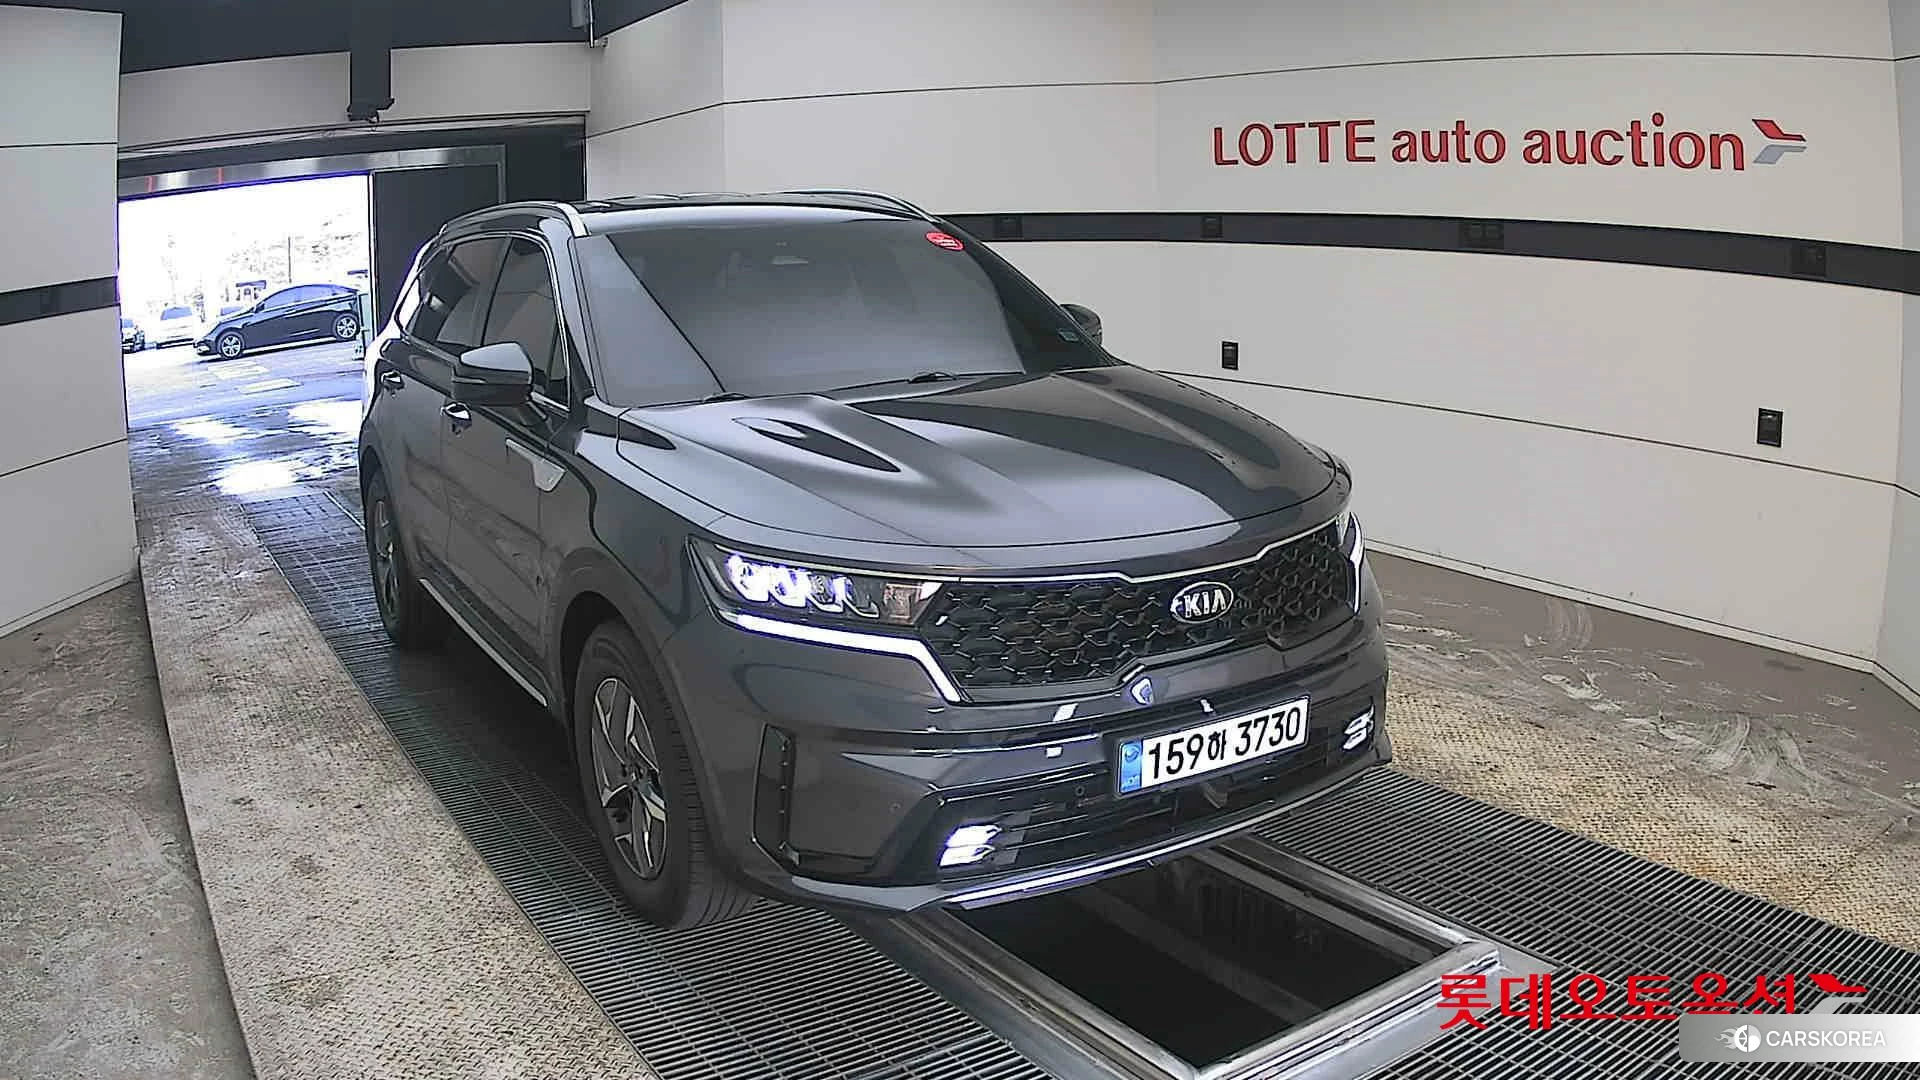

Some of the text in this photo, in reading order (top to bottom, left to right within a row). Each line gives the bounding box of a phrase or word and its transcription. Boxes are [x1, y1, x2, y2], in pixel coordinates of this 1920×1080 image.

[1212, 112, 1745, 171] LOTTE auto auction
[1183, 589, 1227, 618] KIA
[1149, 707, 1301, 779] 159하 3730
